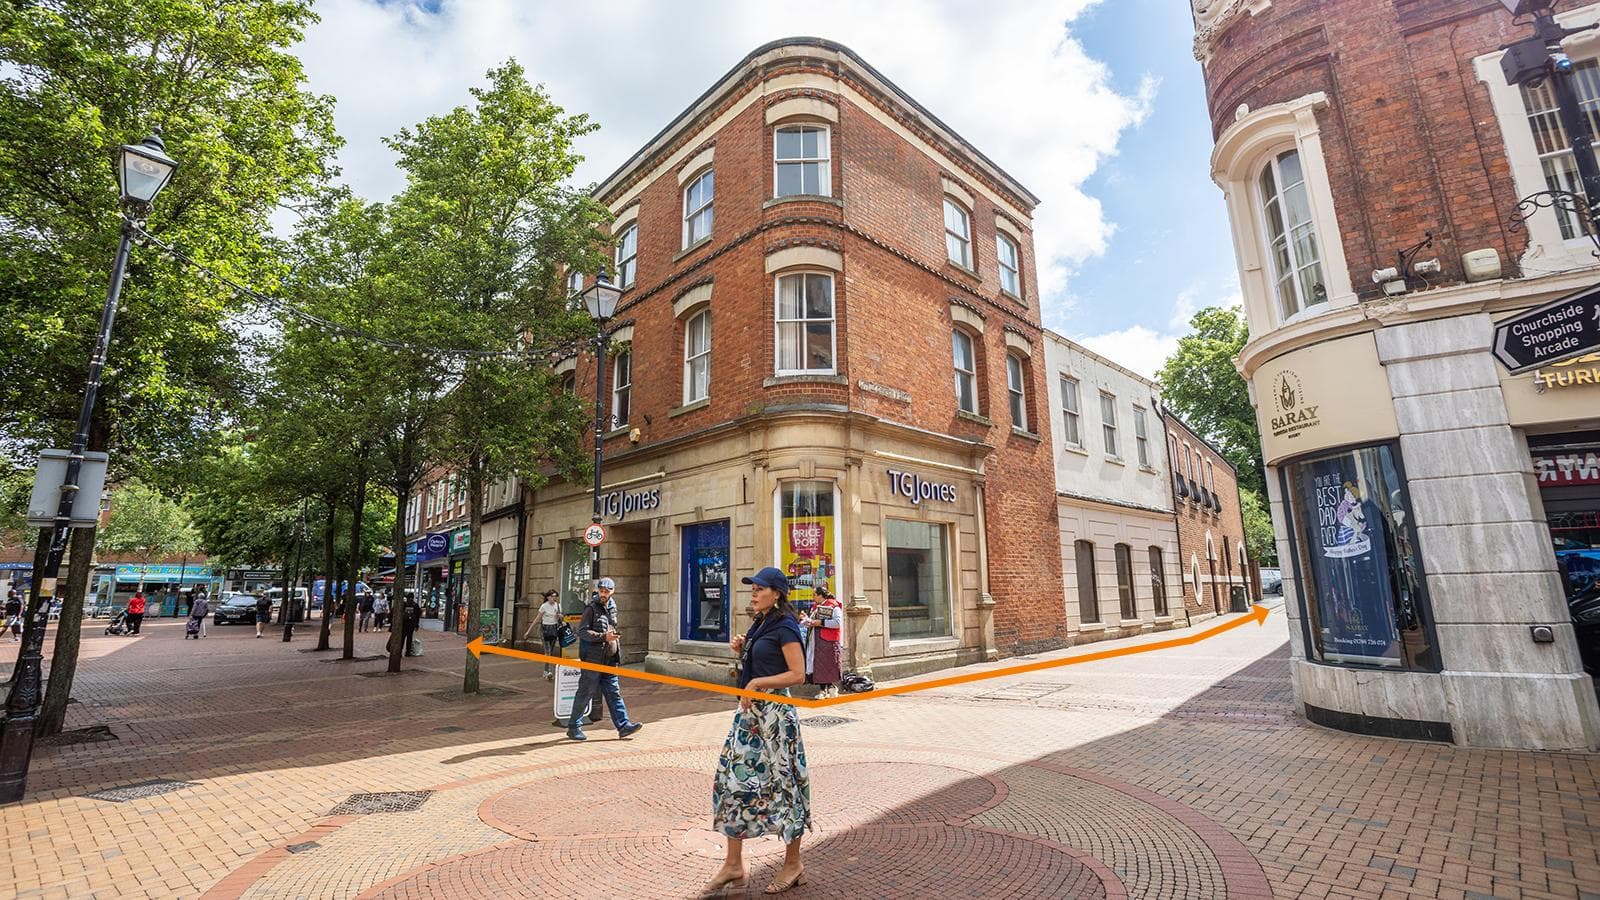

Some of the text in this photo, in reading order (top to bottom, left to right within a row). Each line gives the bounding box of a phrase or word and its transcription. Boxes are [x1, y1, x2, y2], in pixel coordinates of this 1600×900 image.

[1512, 305, 1584, 336] Churchside
[1521, 320, 1584, 347] Shopping
[1534, 336, 1580, 358] Arcade
[1271, 405, 1319, 430] SARAY
[1316, 486, 1341, 507] BEST
[1318, 506, 1336, 526] DAD
[792, 529, 821, 538] PRICE
[795, 537, 819, 548] POP!
[1320, 526, 1337, 546] EVER
